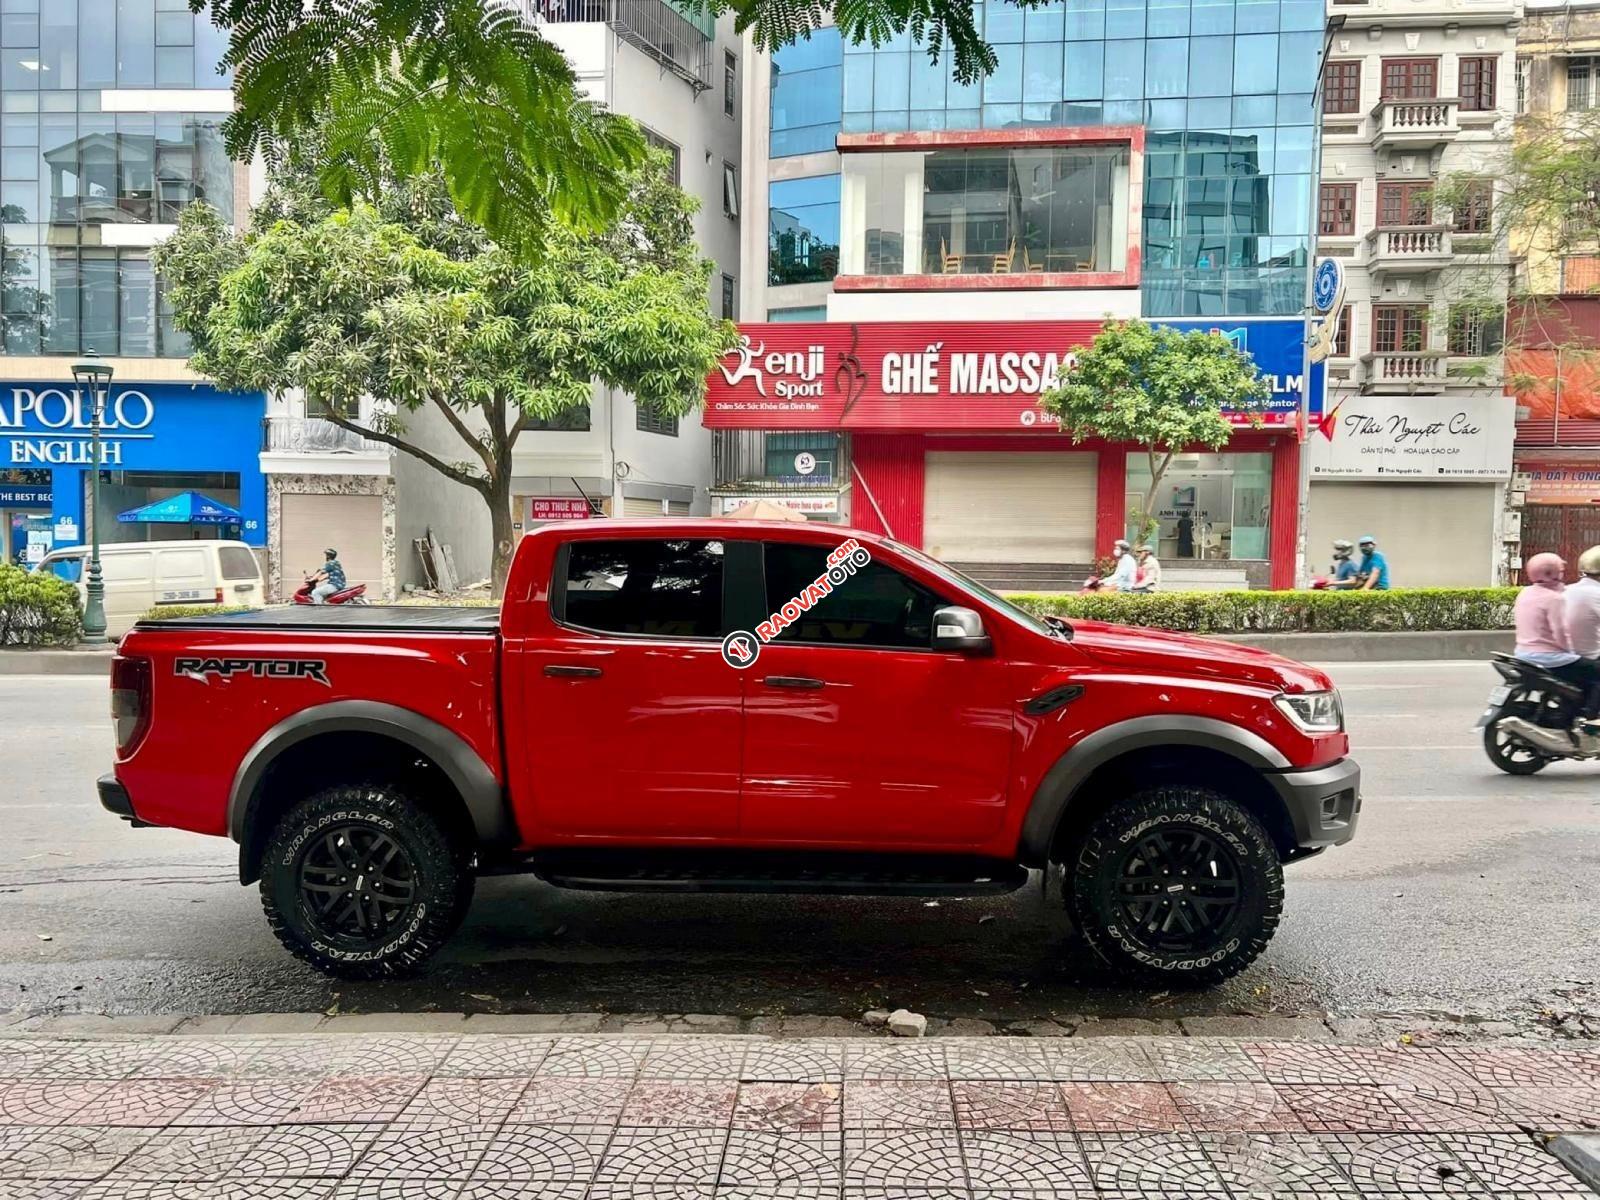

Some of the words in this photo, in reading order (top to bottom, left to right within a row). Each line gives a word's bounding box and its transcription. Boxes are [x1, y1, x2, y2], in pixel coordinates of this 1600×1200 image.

[881, 341, 944, 394] GHẾ
[774, 380, 824, 400] Sport
[1345, 415, 1383, 437] Thái
[1387, 415, 1445, 443] Nguyệt
[1449, 412, 1481, 435] Các
[10, 440, 122, 464] ENGLISH
[15, 493, 36, 501] BEST
[534, 501, 549, 511] CHO
[550, 500, 569, 511] THUÊ
[60, 516, 72, 525] 66
[245, 520, 257, 529] 66
[174, 657, 332, 688] RAPTOR
[282, 811, 394, 865] WRANGLER
[1119, 813, 1248, 856] WRANGLER
